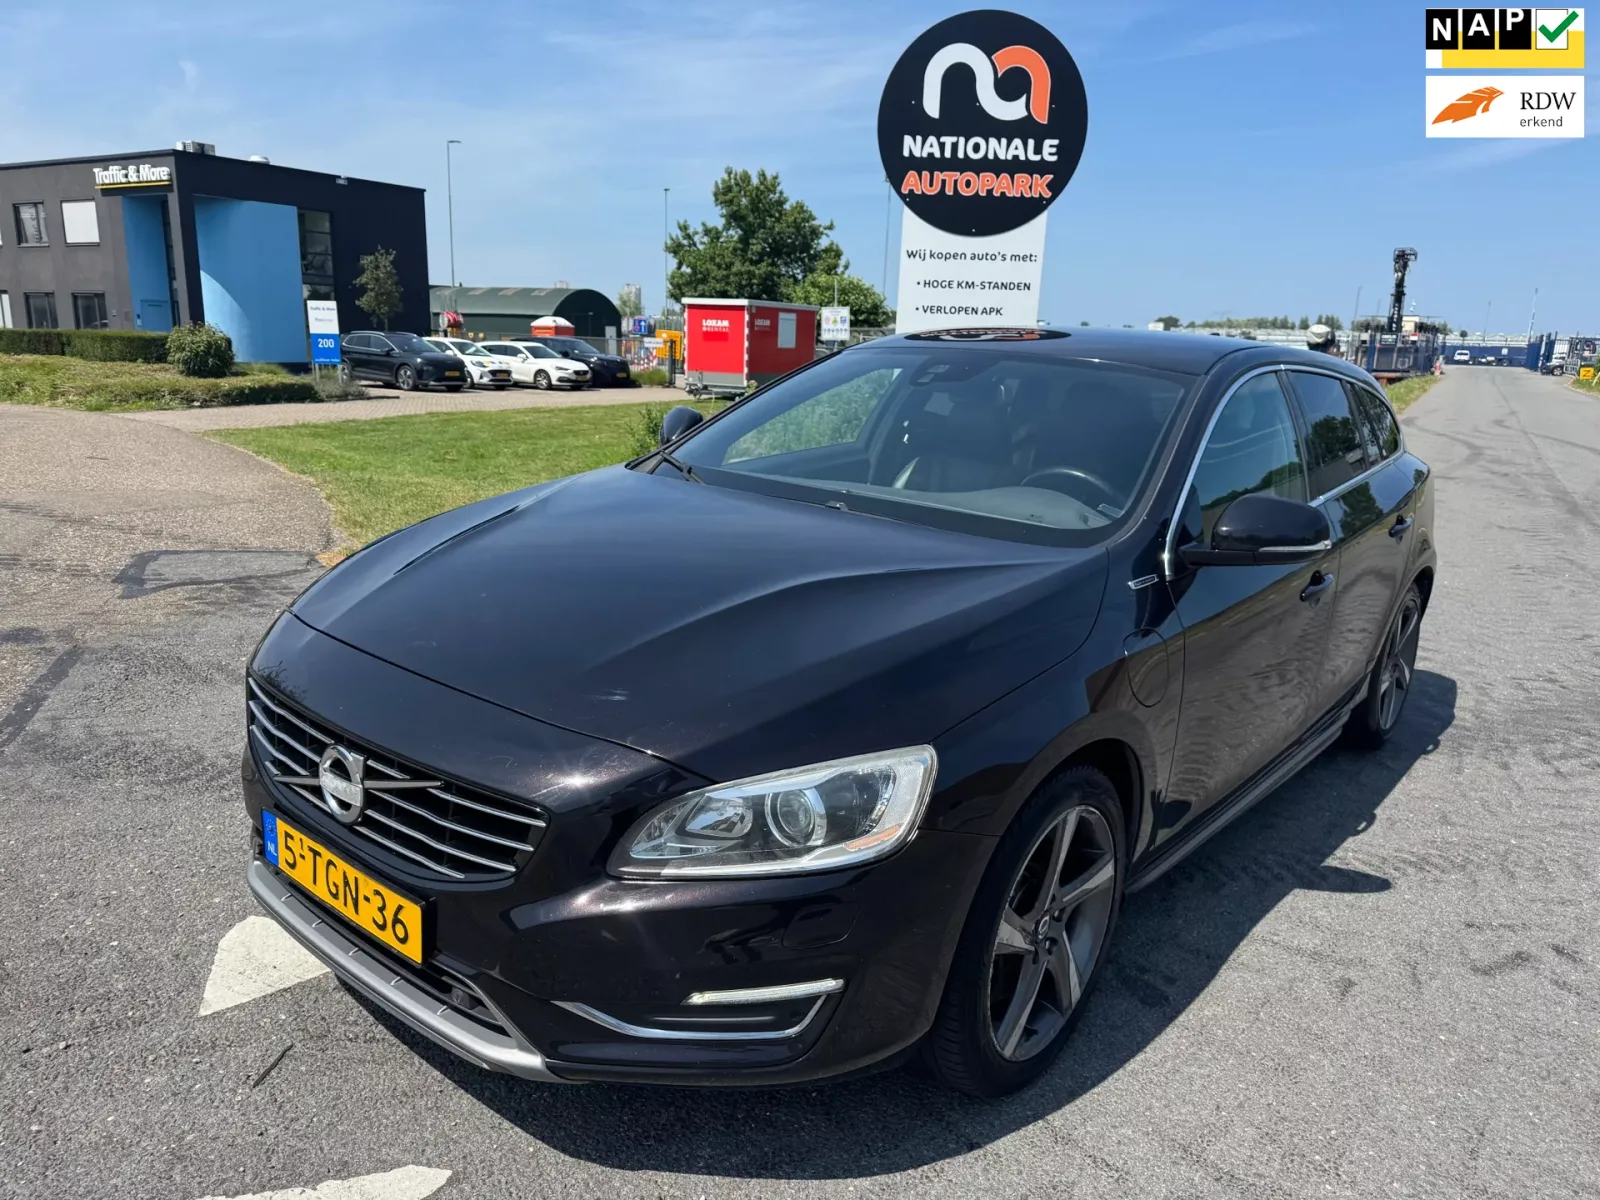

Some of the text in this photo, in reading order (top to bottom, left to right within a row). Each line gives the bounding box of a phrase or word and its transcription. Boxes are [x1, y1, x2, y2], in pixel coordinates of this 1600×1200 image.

[902, 134, 1060, 162] NATIONALE
[93, 164, 171, 184] Traffic & More
[901, 170, 1054, 198] AUTOPARK
[906, 249, 1038, 262] Wij kopen auto's met:
[923, 279, 1031, 291] HOGE KM-STANDEN
[921, 304, 1004, 317] VERLOPEN APK
[702, 319, 729, 327] LOXAM
[318, 338, 335, 348] 200
[267, 841, 278, 857] NL
[284, 829, 409, 945] 5-TGN-36
